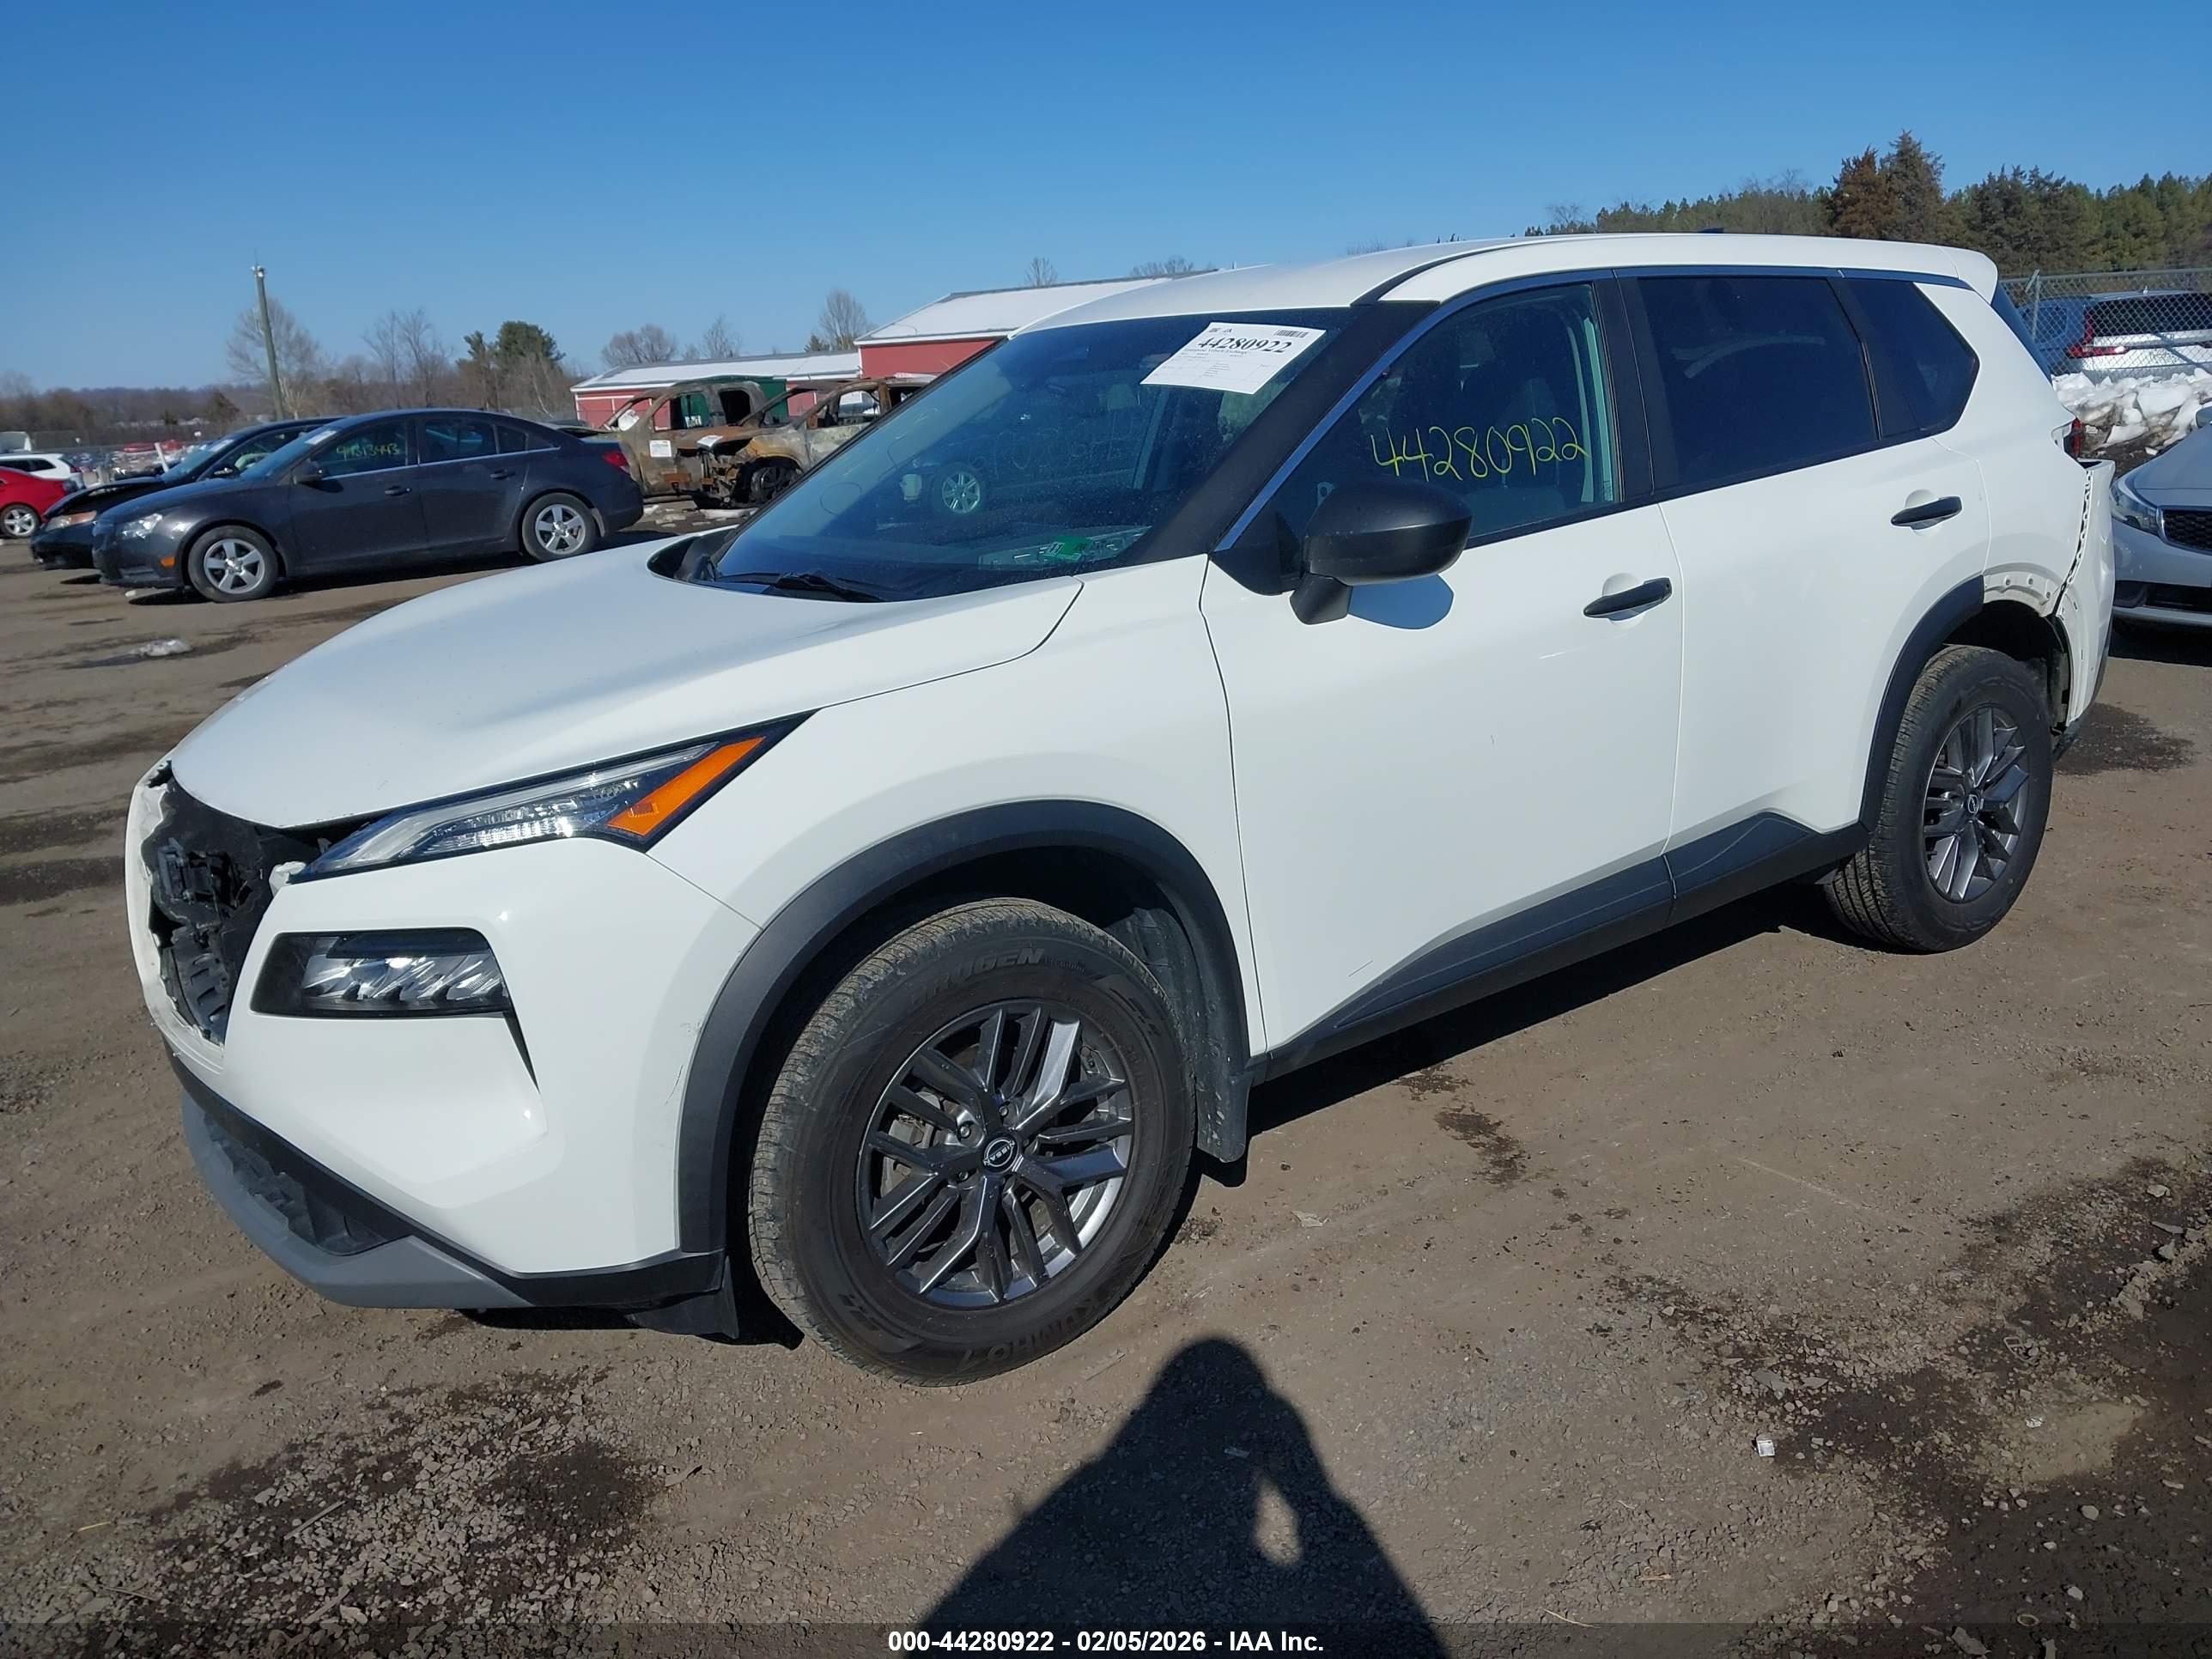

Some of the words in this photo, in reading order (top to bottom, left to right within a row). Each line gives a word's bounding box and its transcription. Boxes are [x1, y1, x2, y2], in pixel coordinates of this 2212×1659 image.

[1198, 337, 1292, 353] 44280922
[1370, 417, 1590, 482] 44280922
[982, 1140, 1015, 1165] NISSAN
